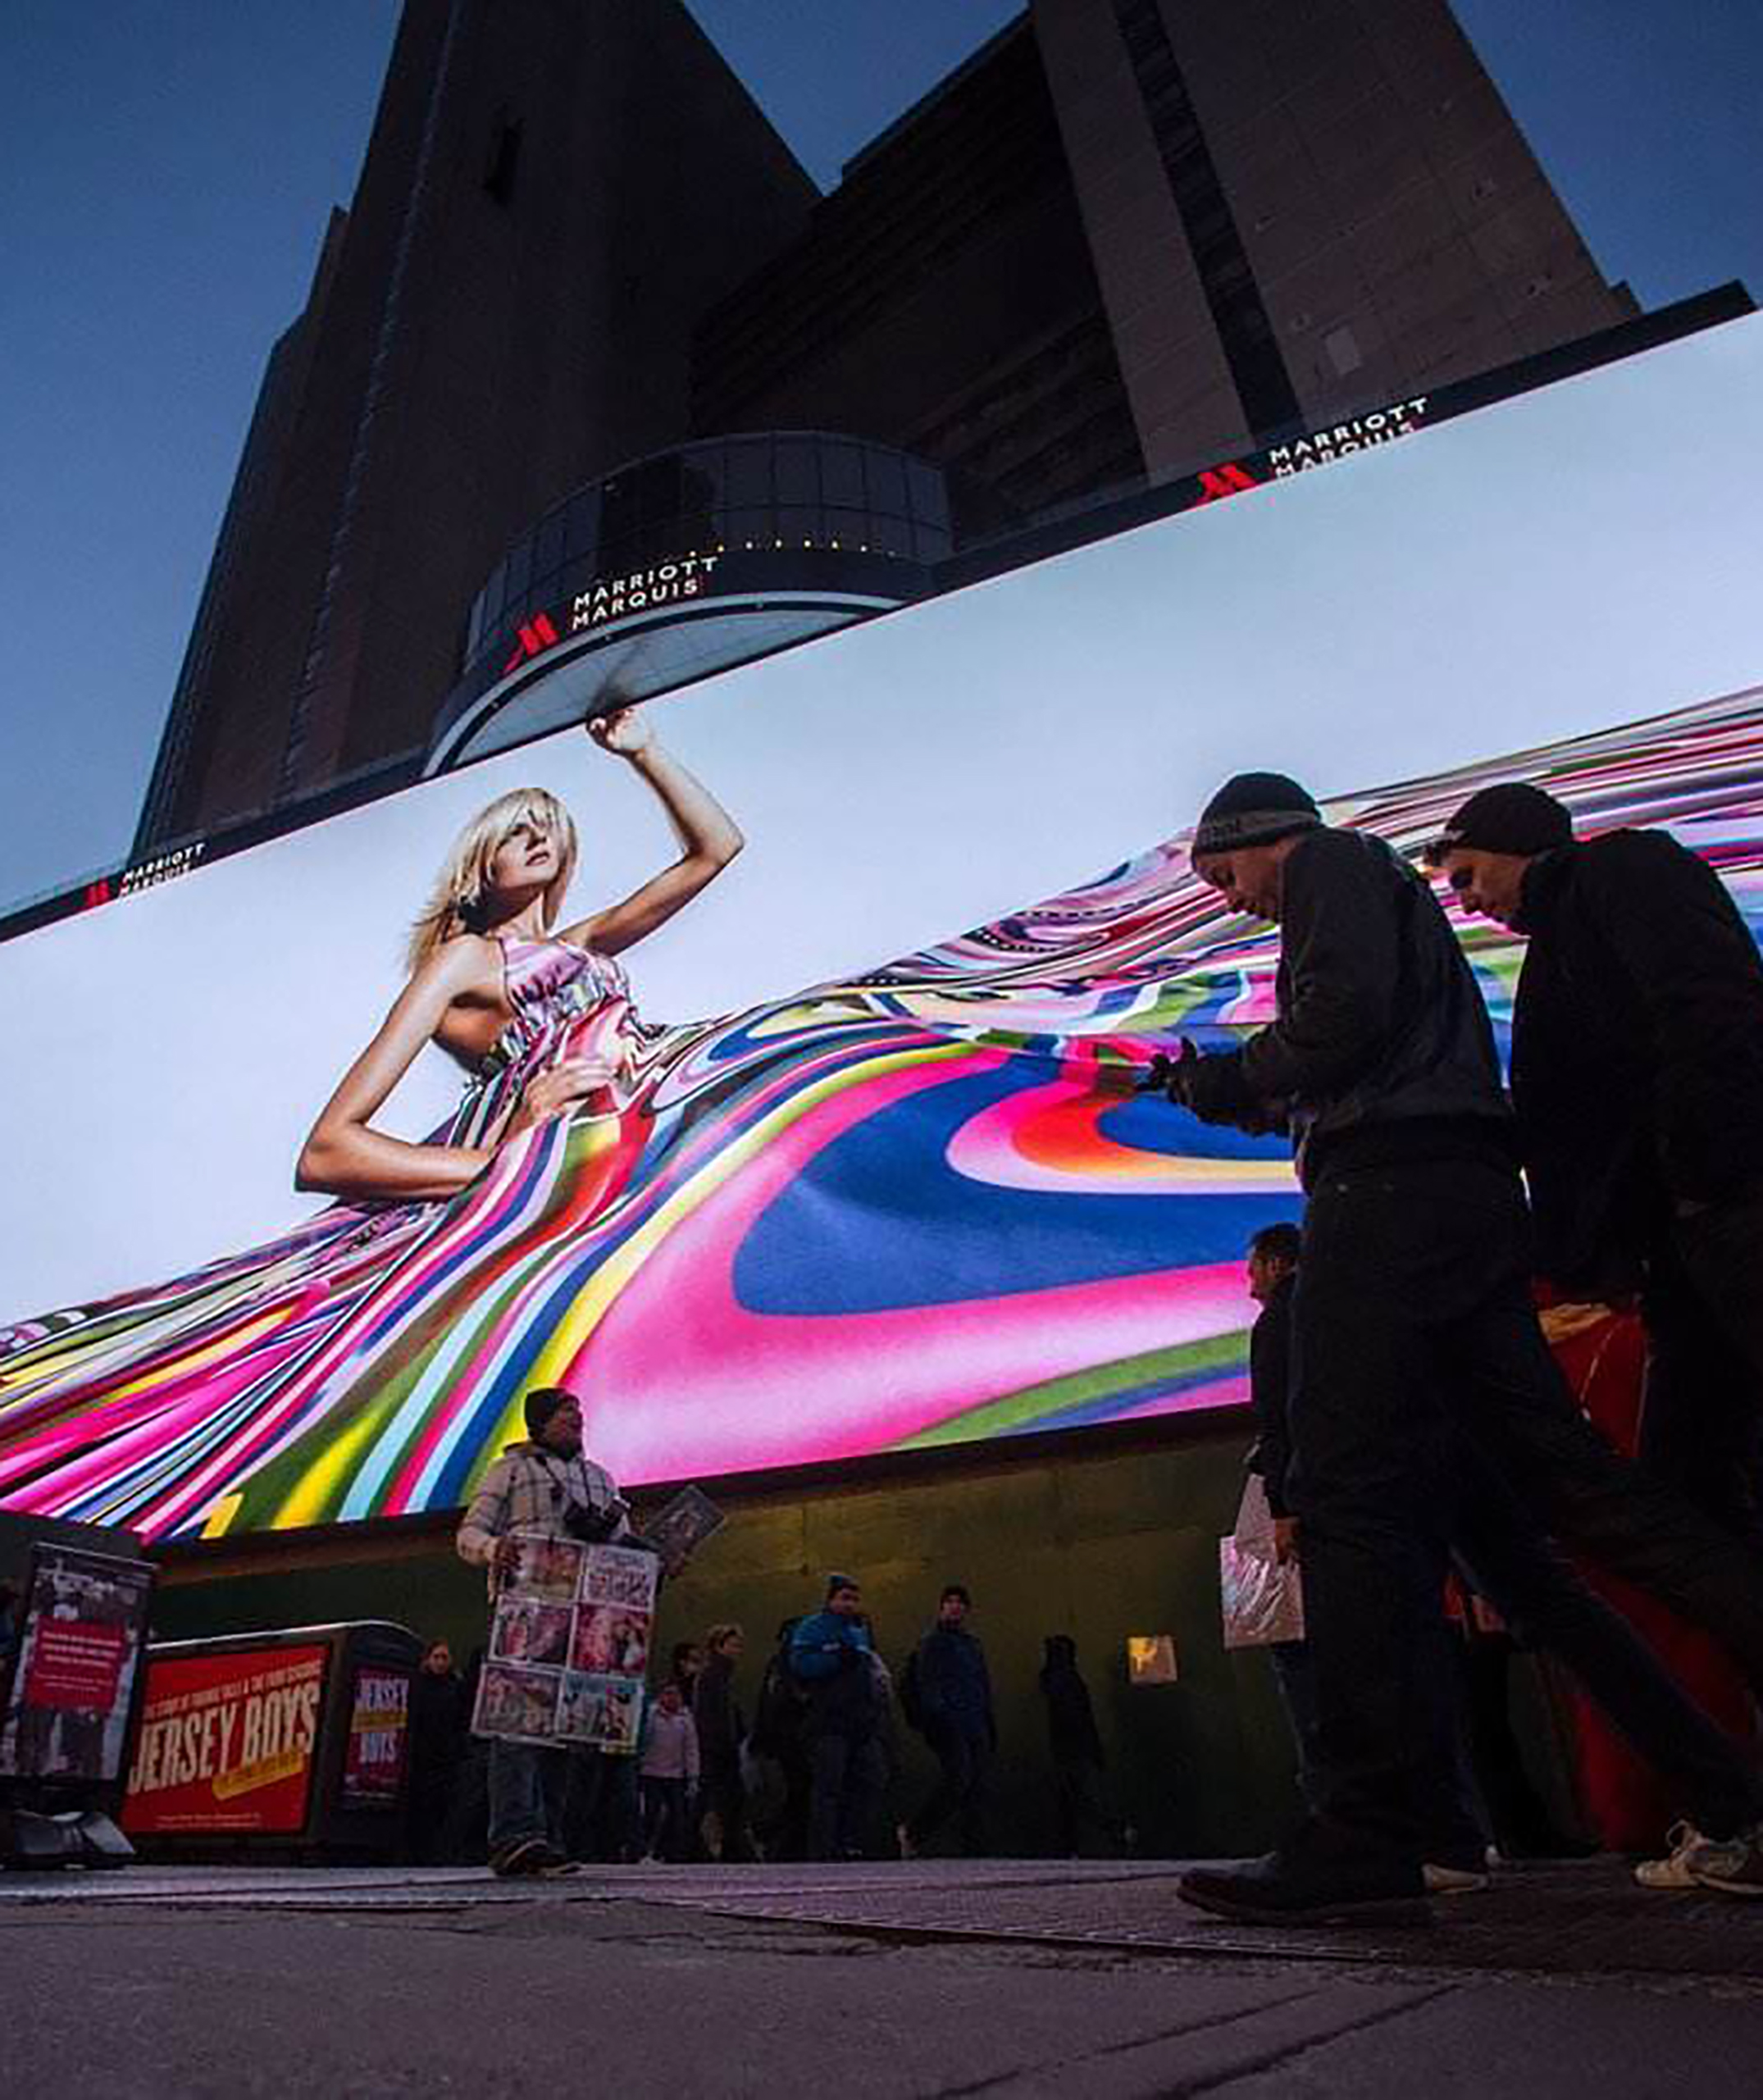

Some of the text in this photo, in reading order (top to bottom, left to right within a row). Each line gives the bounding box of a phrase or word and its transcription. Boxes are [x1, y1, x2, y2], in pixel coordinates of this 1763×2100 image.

[1270, 397, 1428, 465] MARRIOTT
[572, 578, 698, 631] MARQUIS
[573, 556, 718, 612] MARRIOTT
[123, 842, 205, 883] MARRIOTT
[126, 1701, 237, 1796] JERSEY
[240, 1679, 321, 1768] BOYS
